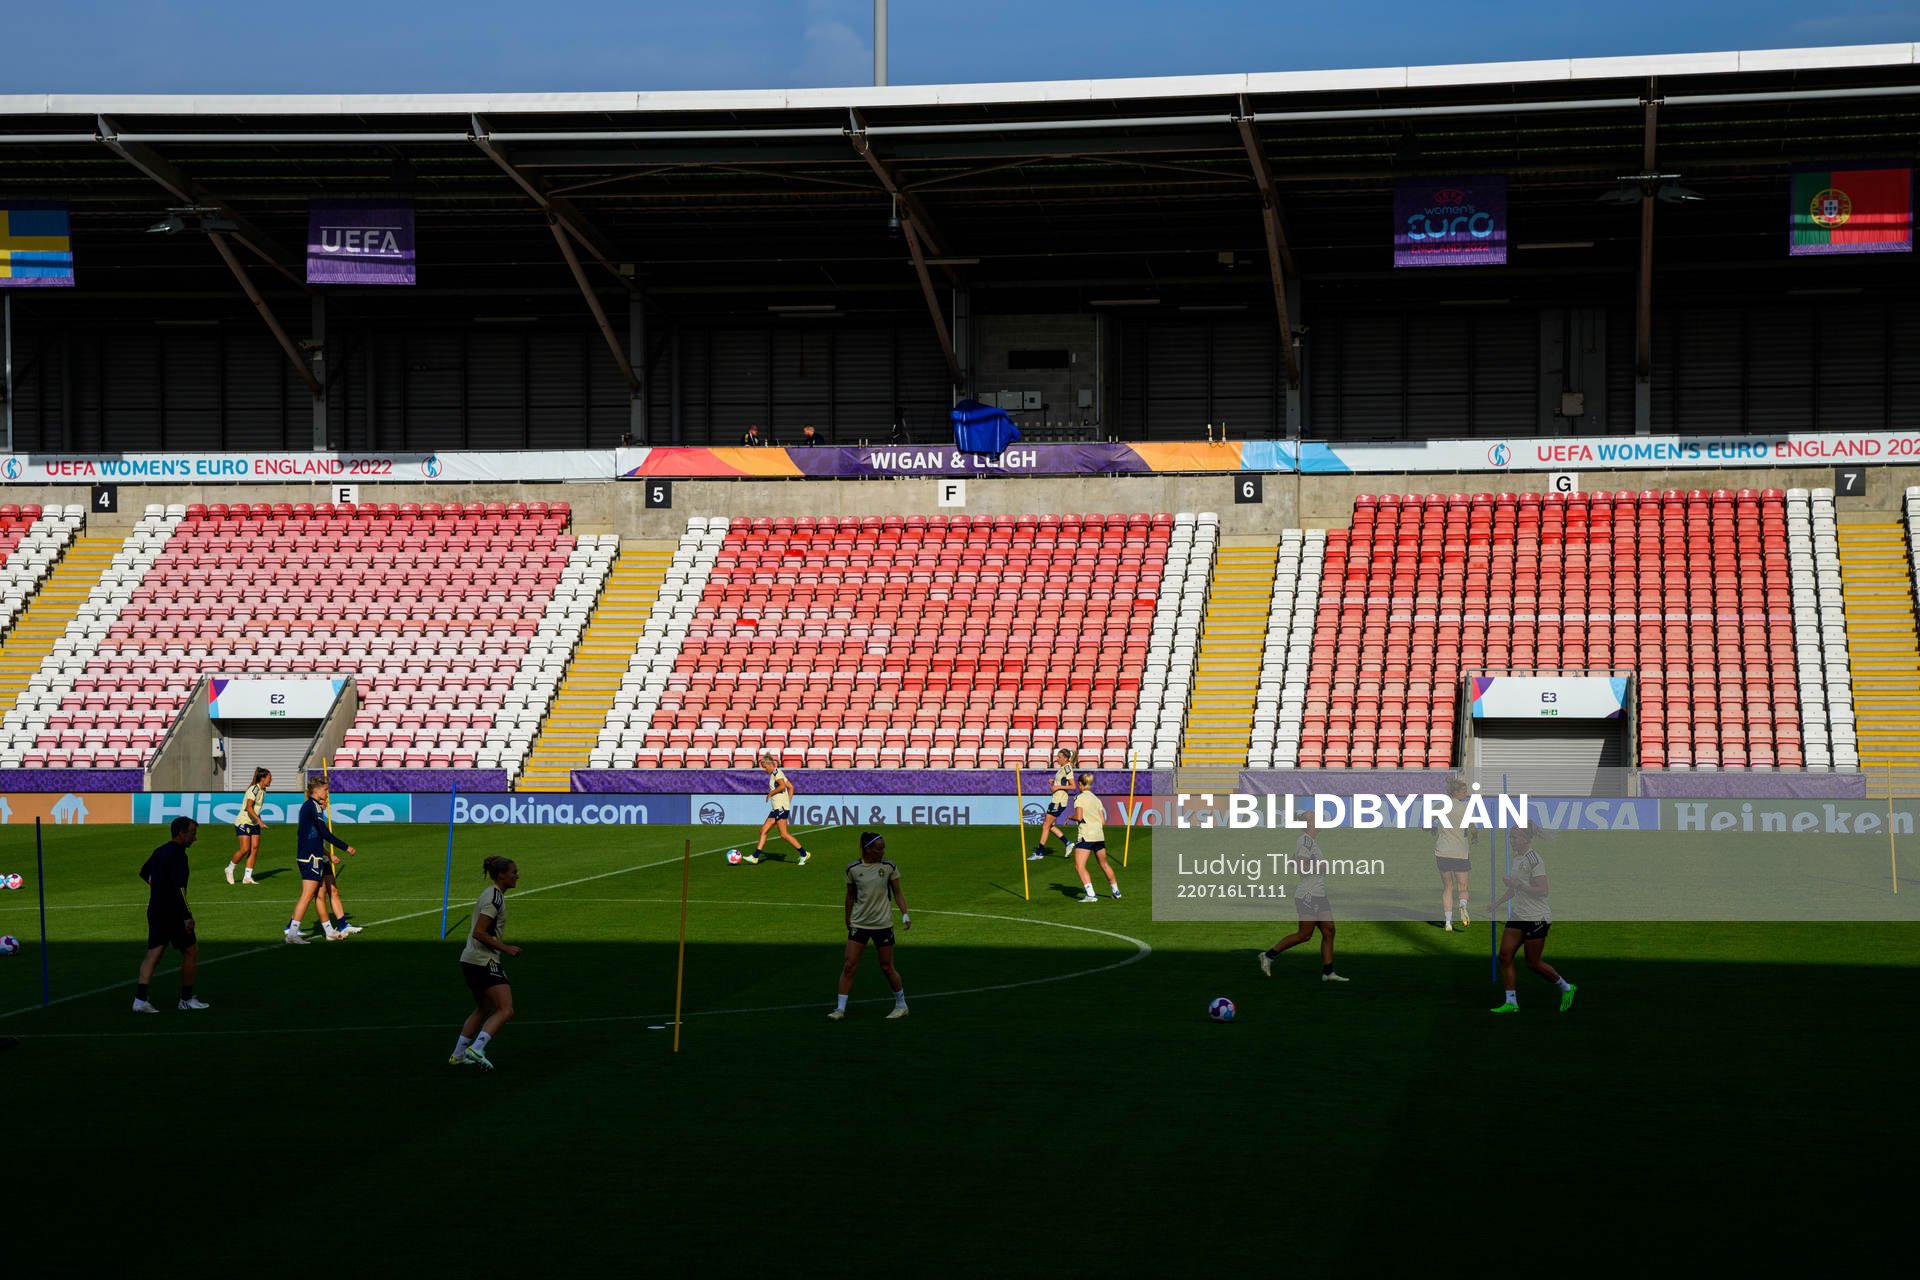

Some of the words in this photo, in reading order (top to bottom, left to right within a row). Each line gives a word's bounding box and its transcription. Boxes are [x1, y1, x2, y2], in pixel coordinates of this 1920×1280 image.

[322, 230, 400, 253] UEFA
[1411, 243, 1462, 254] ENGLAND
[1465, 242, 1489, 253] 2022
[1537, 445, 1593, 462] UEFA
[1597, 442, 1701, 461] WOMEN'S
[1707, 441, 1768, 459] EURO
[1775, 439, 1882, 458] ENGLAND
[46, 460, 96, 476] UEFA
[100, 459, 191, 475] WOMEN'S
[196, 459, 249, 475] EURO
[254, 459, 344, 475] ENGLAND
[349, 459, 393, 475] 2022
[871, 451, 943, 469] WIGAN
[950, 452, 965, 468] &
[1243, 481, 1255, 498] 6
[1556, 476, 1571, 492] G
[1844, 473, 1857, 490] 7
[99, 492, 110, 507] 4
[339, 488, 351, 503] E
[653, 487, 664, 503] 5
[946, 485, 957, 501] F
[270, 694, 285, 704] E2
[1541, 692, 1557, 703] E3
[453, 797, 648, 825] Booking.com
[869, 805, 886, 825] &
[896, 806, 970, 825] LEIGH
[1528, 801, 1640, 829] VISA
[1675, 802, 1914, 834] Heineken
